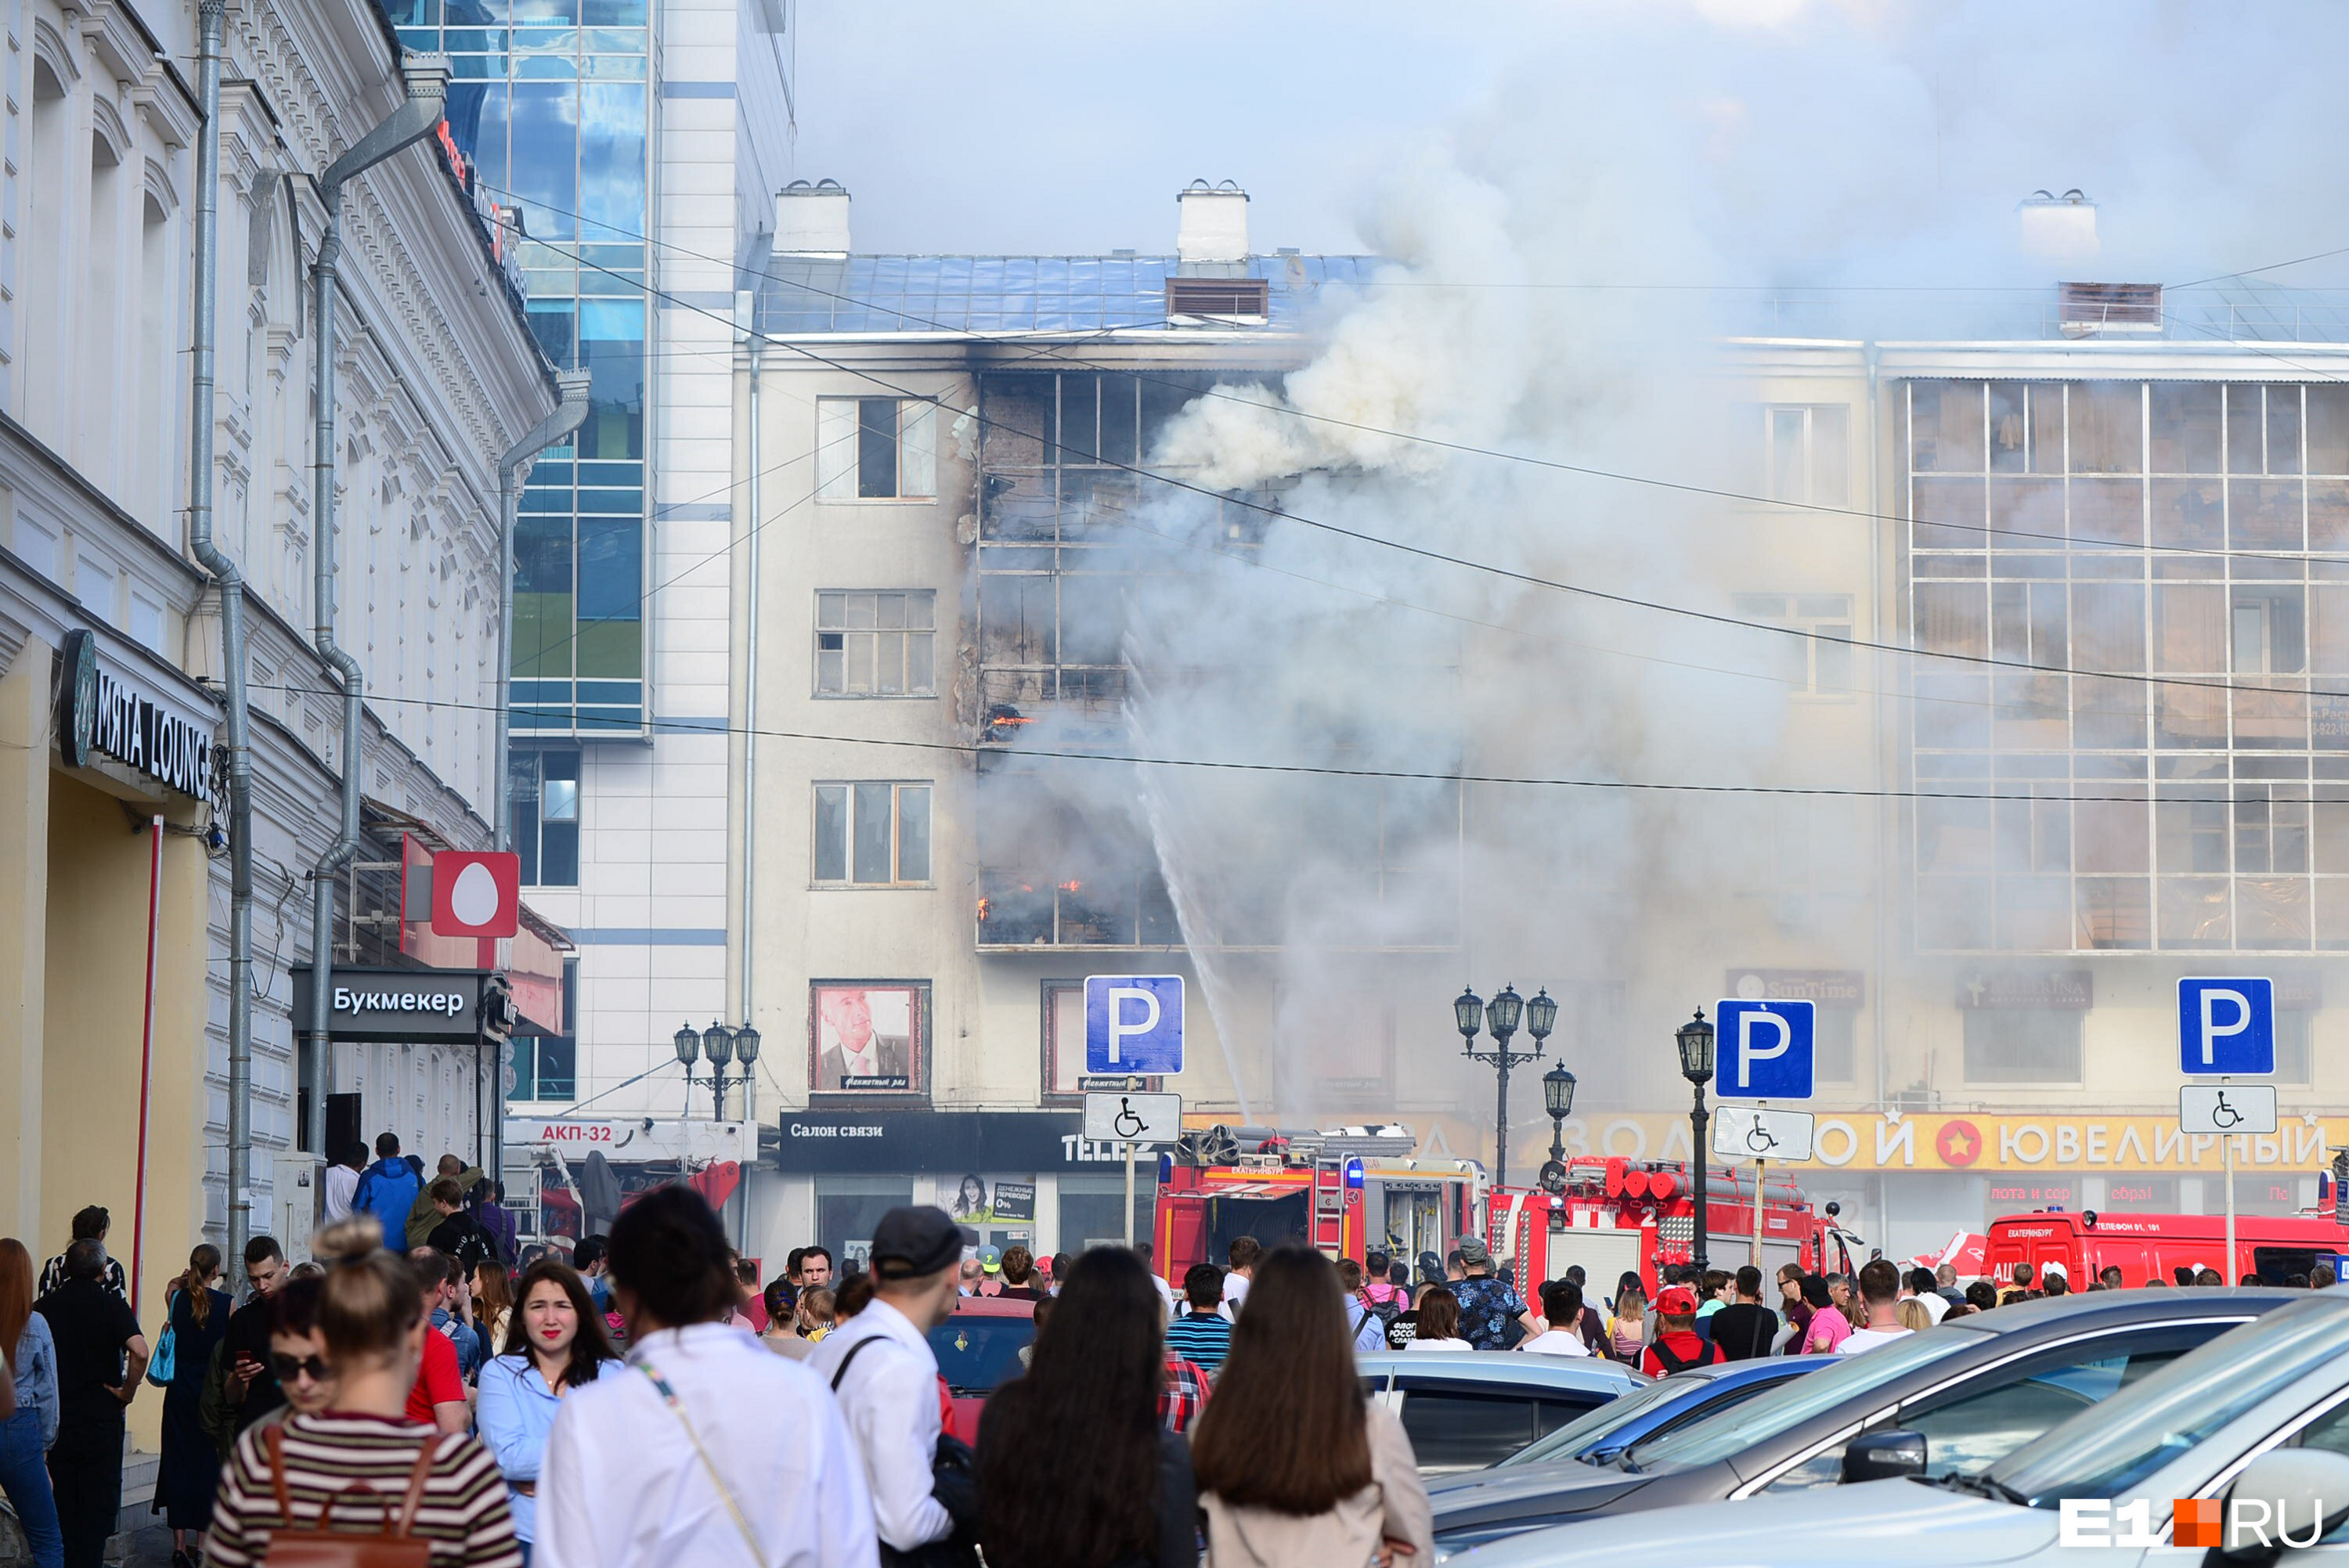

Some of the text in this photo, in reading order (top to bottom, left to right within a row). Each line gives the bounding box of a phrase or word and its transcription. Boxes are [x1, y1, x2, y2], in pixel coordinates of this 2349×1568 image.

[97, 672, 143, 768] МЯТА
[1767, 981, 1858, 999] SunTime
[334, 987, 464, 1017] Букмекер
[1108, 987, 1160, 1064] P
[2200, 989, 2251, 1065] P
[1738, 1011, 1791, 1088] P
[542, 1126, 612, 1141] АКП-32
[790, 1123, 884, 1137] Салон связи
[1565, 1116, 2326, 1166] ЗОЛОЙ ЮВЕЛИРНЫЙ
[1231, 1166, 1286, 1176] ЕКАТЕРИНБУРГ
[996, 1191, 1031, 1201] ПЕРЕВОДЫ
[996, 1199, 1012, 1209] 0%
[1640, 1206, 1658, 1227] 2
[2008, 1228, 2054, 1238] ЕКАТЕРИНБУРГ
[2096, 1222, 2133, 1231] ТЕЛЕФОН
[1388, 1329, 1416, 1338] РОССИ
